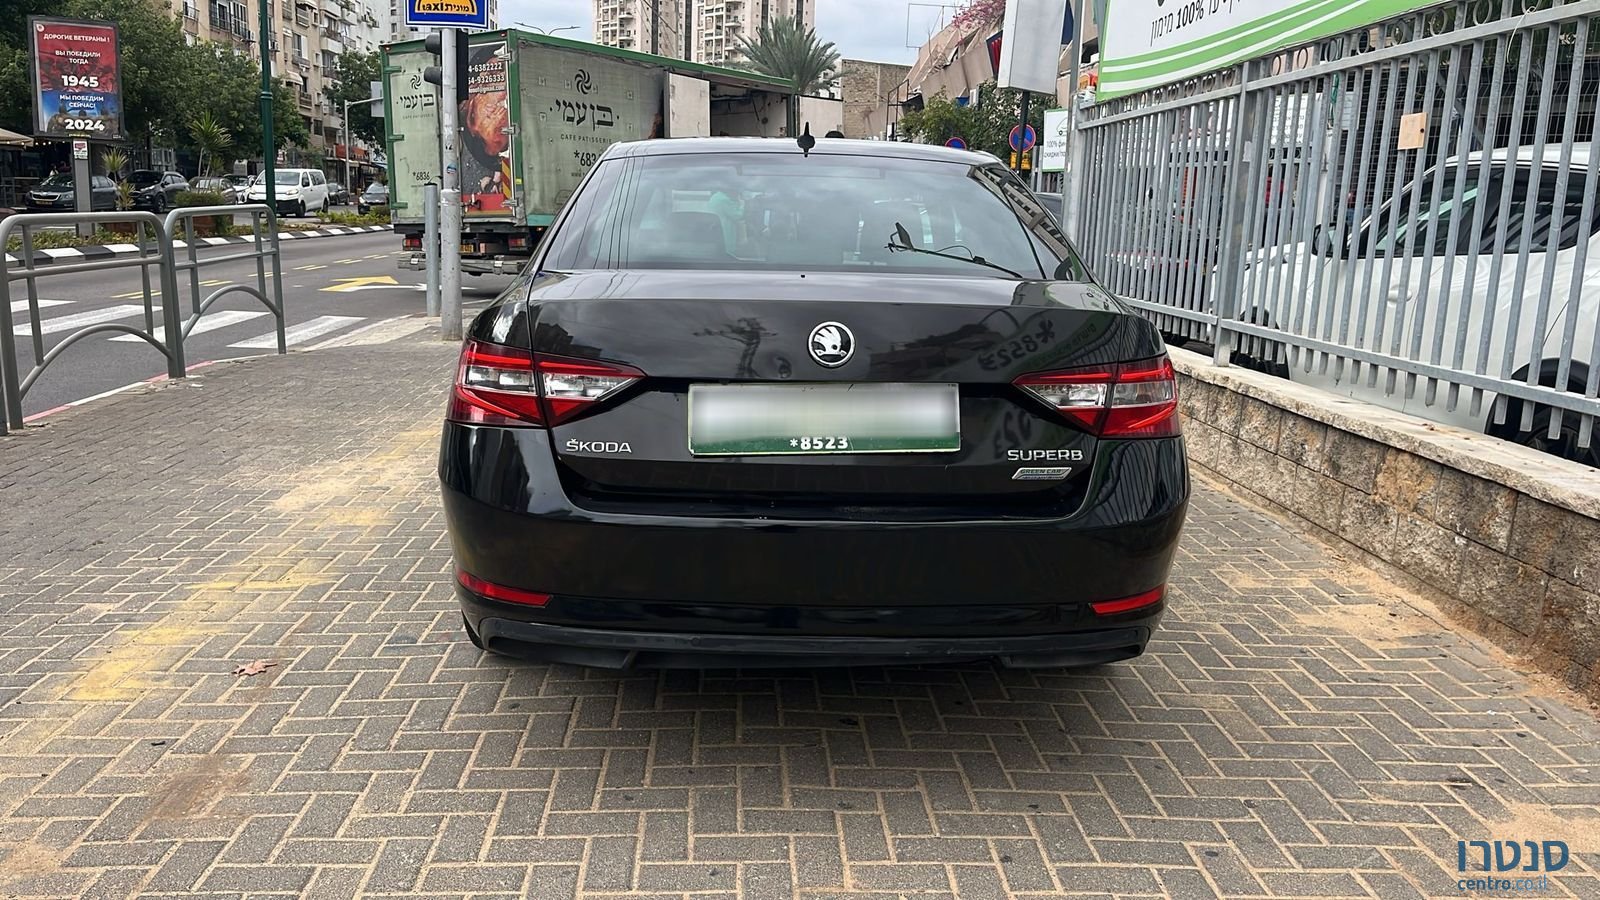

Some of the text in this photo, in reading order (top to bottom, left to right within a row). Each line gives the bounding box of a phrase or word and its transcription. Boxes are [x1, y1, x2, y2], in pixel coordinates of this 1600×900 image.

[422, 3, 443, 11] taxi
[445, 4, 469, 12] מונית
[1176, 0, 1204, 29] 100%
[1150, 17, 1173, 47] מימון
[61, 75, 99, 88] 1945
[68, 101, 96, 109] СЕЙЧАС!
[400, 94, 418, 109] עמי
[555, 99, 613, 131] בן עמי
[64, 118, 105, 131] 2024
[560, 133, 612, 144] CAFE PATISSERIE
[573, 150, 601, 167] 683
[566, 438, 632, 453] ŠKODA
[1007, 449, 1083, 461] SUPERB
